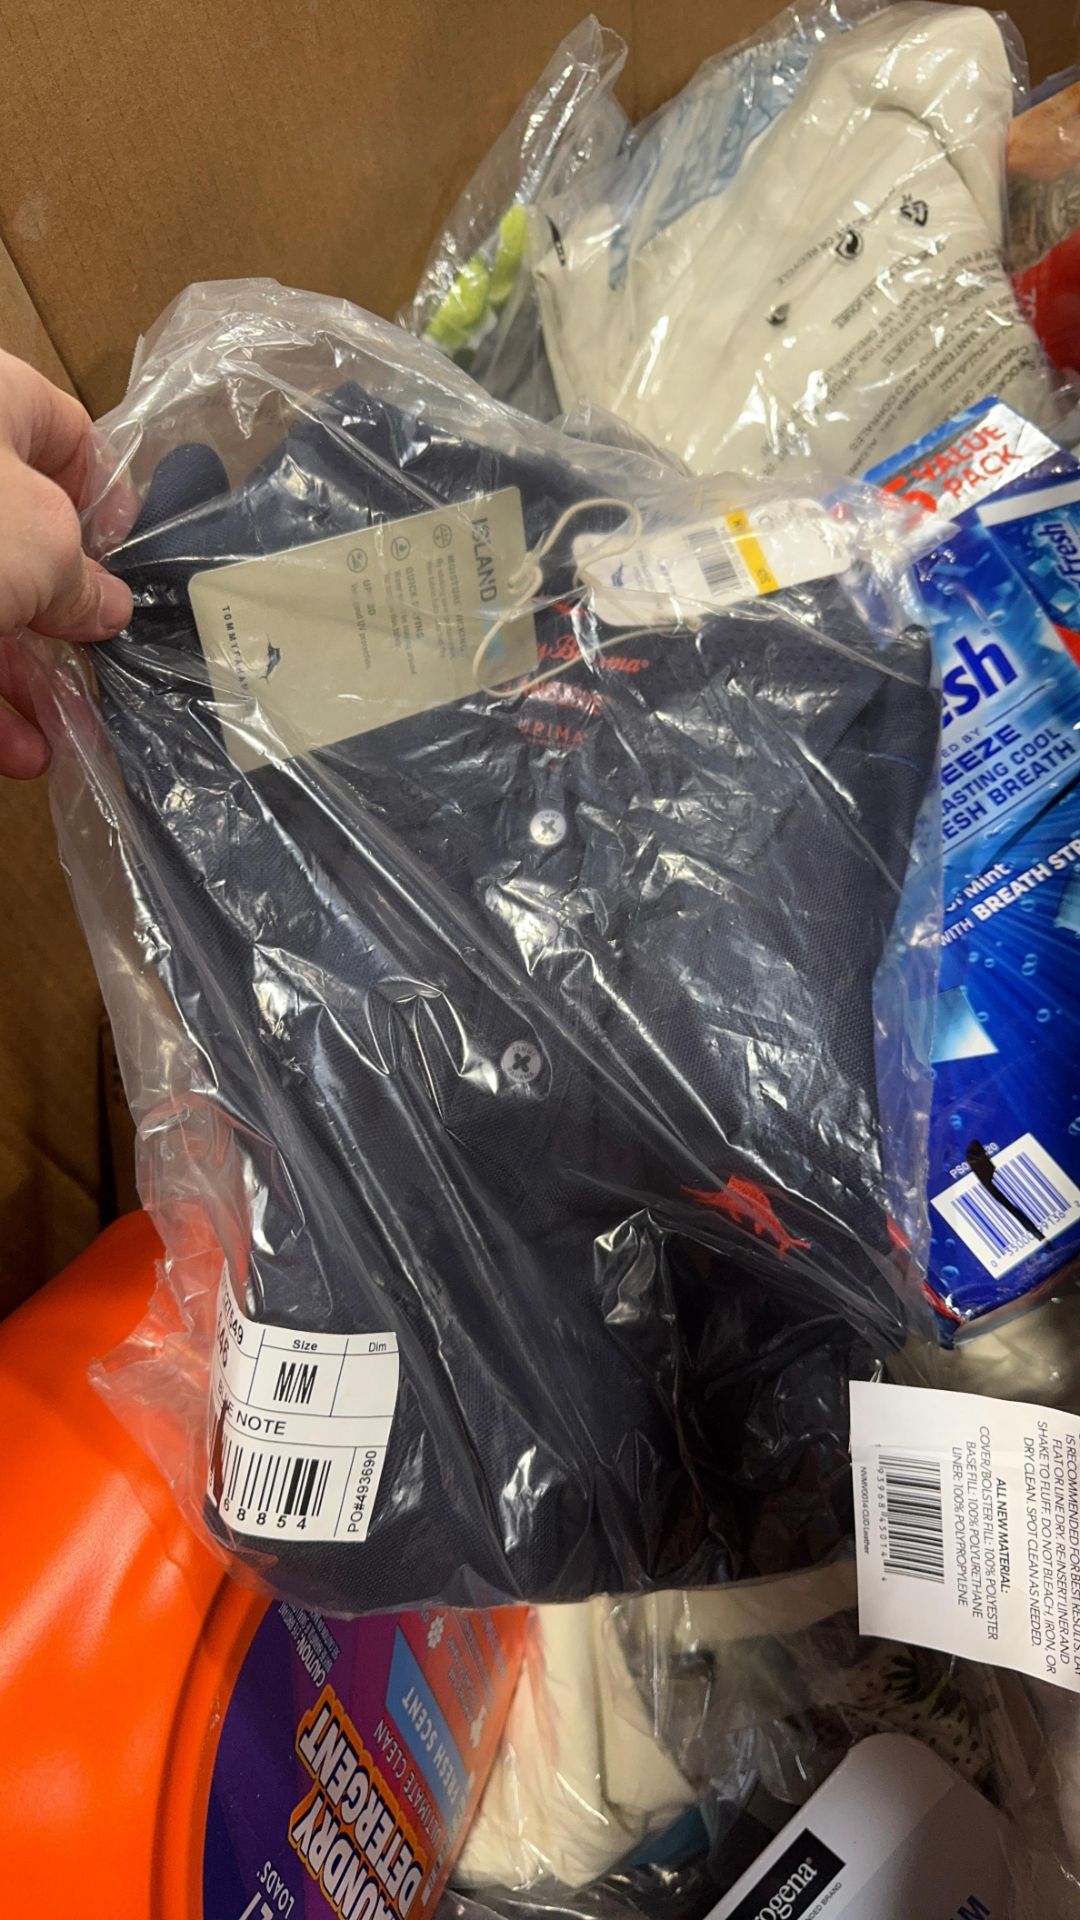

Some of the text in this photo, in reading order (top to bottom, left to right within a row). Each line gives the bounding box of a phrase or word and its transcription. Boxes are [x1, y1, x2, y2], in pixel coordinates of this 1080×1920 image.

[923, 424, 1006, 483] VALUE
[949, 447, 1022, 500] PACK
[961, 727, 982, 744] BY
[1011, 727, 1061, 765] COOL
[941, 739, 1076, 842] ESH BREATH
[940, 917, 975, 946] WITH
[971, 863, 1054, 921] BREATH
[963, 863, 1012, 899] Mint
[292, 1338, 387, 1352] Size Dim
[273, 1360, 318, 1404] M/M
[236, 1411, 287, 1436] NOTE
[1065, 1434, 1075, 1446] IS
[346, 1449, 377, 1534] PO#493690
[1063, 1446, 1080, 1545] RECOMMENDED
[950, 1446, 970, 1606] LINER: 100% POLYPROPYLENE
[964, 1440, 984, 1619] BASE FILL: 100% POLYURETHANE
[976, 1425, 999, 1640] COVER/BOLSTER FILL: 100% POLYESTER
[994, 1477, 1011, 1593] ALL NEW MATERIAL:
[1023, 1436, 1042, 1646] DRY CLEAN. SPOT CLEAN AS NEEDED.
[1036, 1420, 1056, 1674] SHAKE TO FLUFF. DO NOT BLEACH, IRON, OR
[1051, 1438, 1070, 1664] FLAT OR LINE DRY. RE-INSERT LINER AND
[1068, 1546, 1080, 1572] FOR
[1069, 1573, 1080, 1600] BEST
[296, 1632, 326, 1687] CAUTION:
[371, 1717, 410, 1779] CLEAN
[399, 1685, 438, 1752] SCENT
[295, 1702, 423, 1919] DETERGENT
[820, 1881, 843, 1906] BRAND
